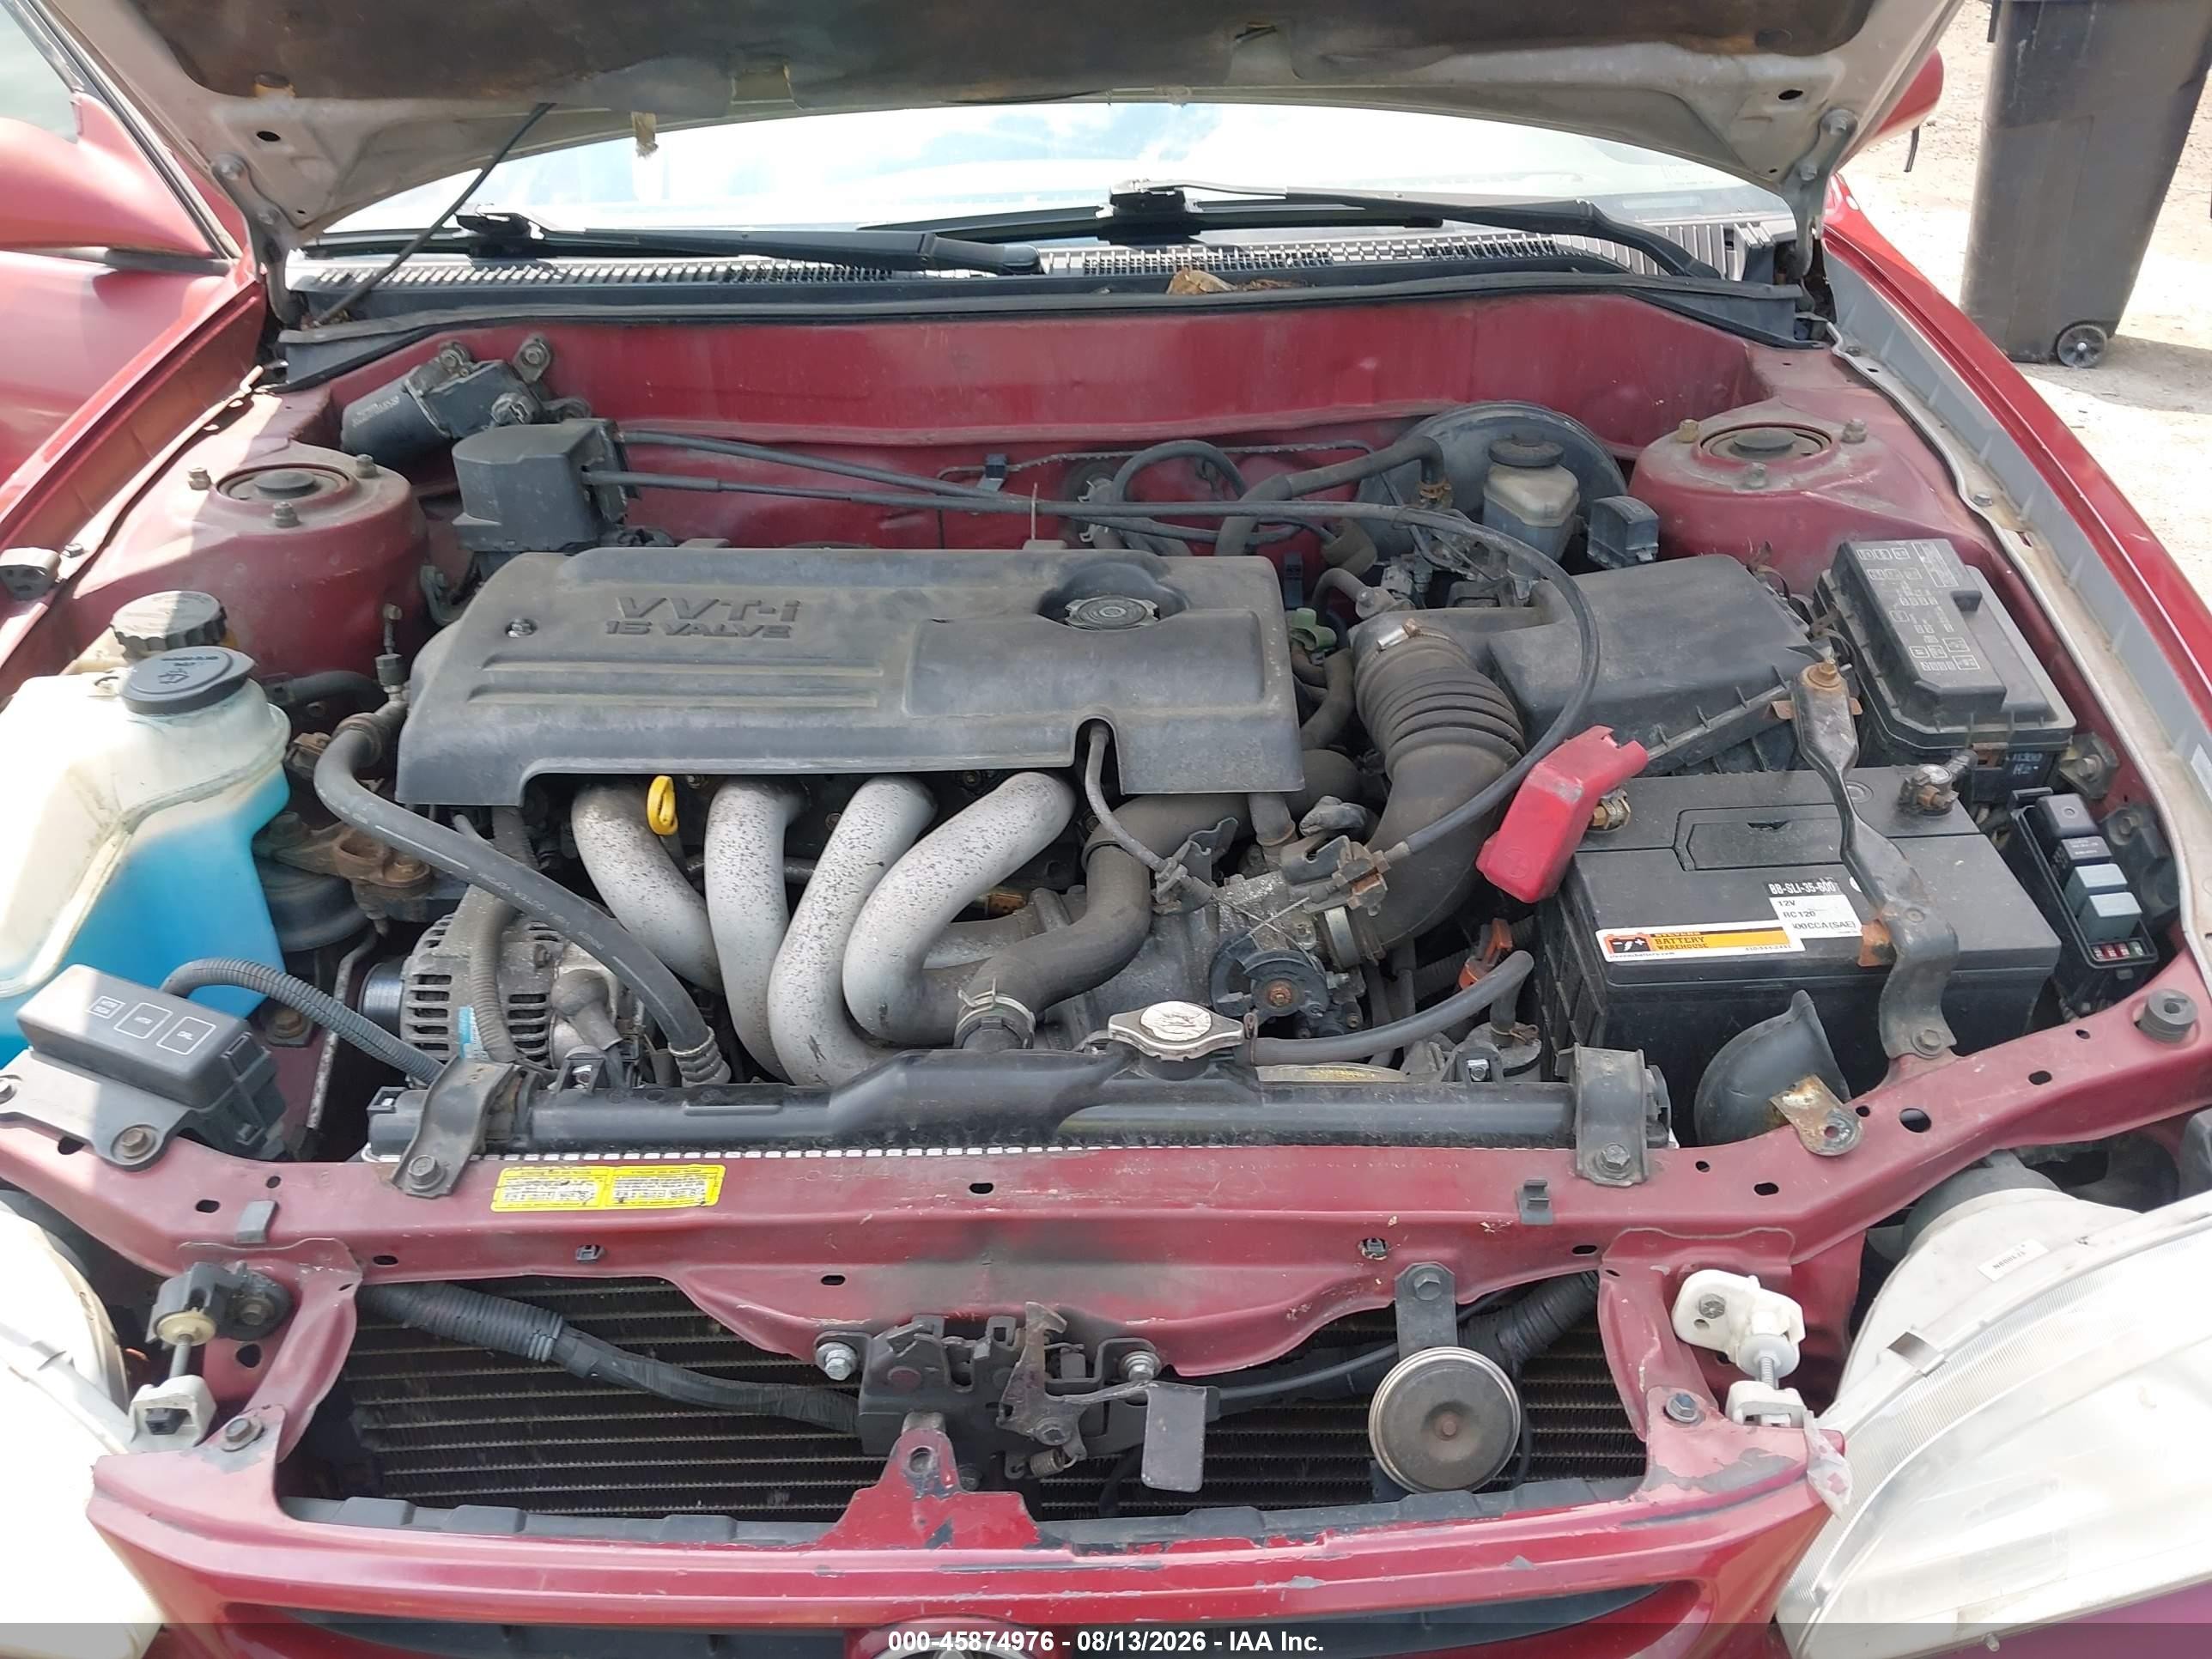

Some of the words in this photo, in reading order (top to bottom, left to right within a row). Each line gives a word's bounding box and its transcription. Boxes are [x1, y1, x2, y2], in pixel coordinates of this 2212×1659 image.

[605, 620, 653, 635] 16
[659, 622, 793, 639] VALVE
[1654, 936, 1705, 945] BATTERY
[1656, 943, 1710, 951] WAREHOUSE
